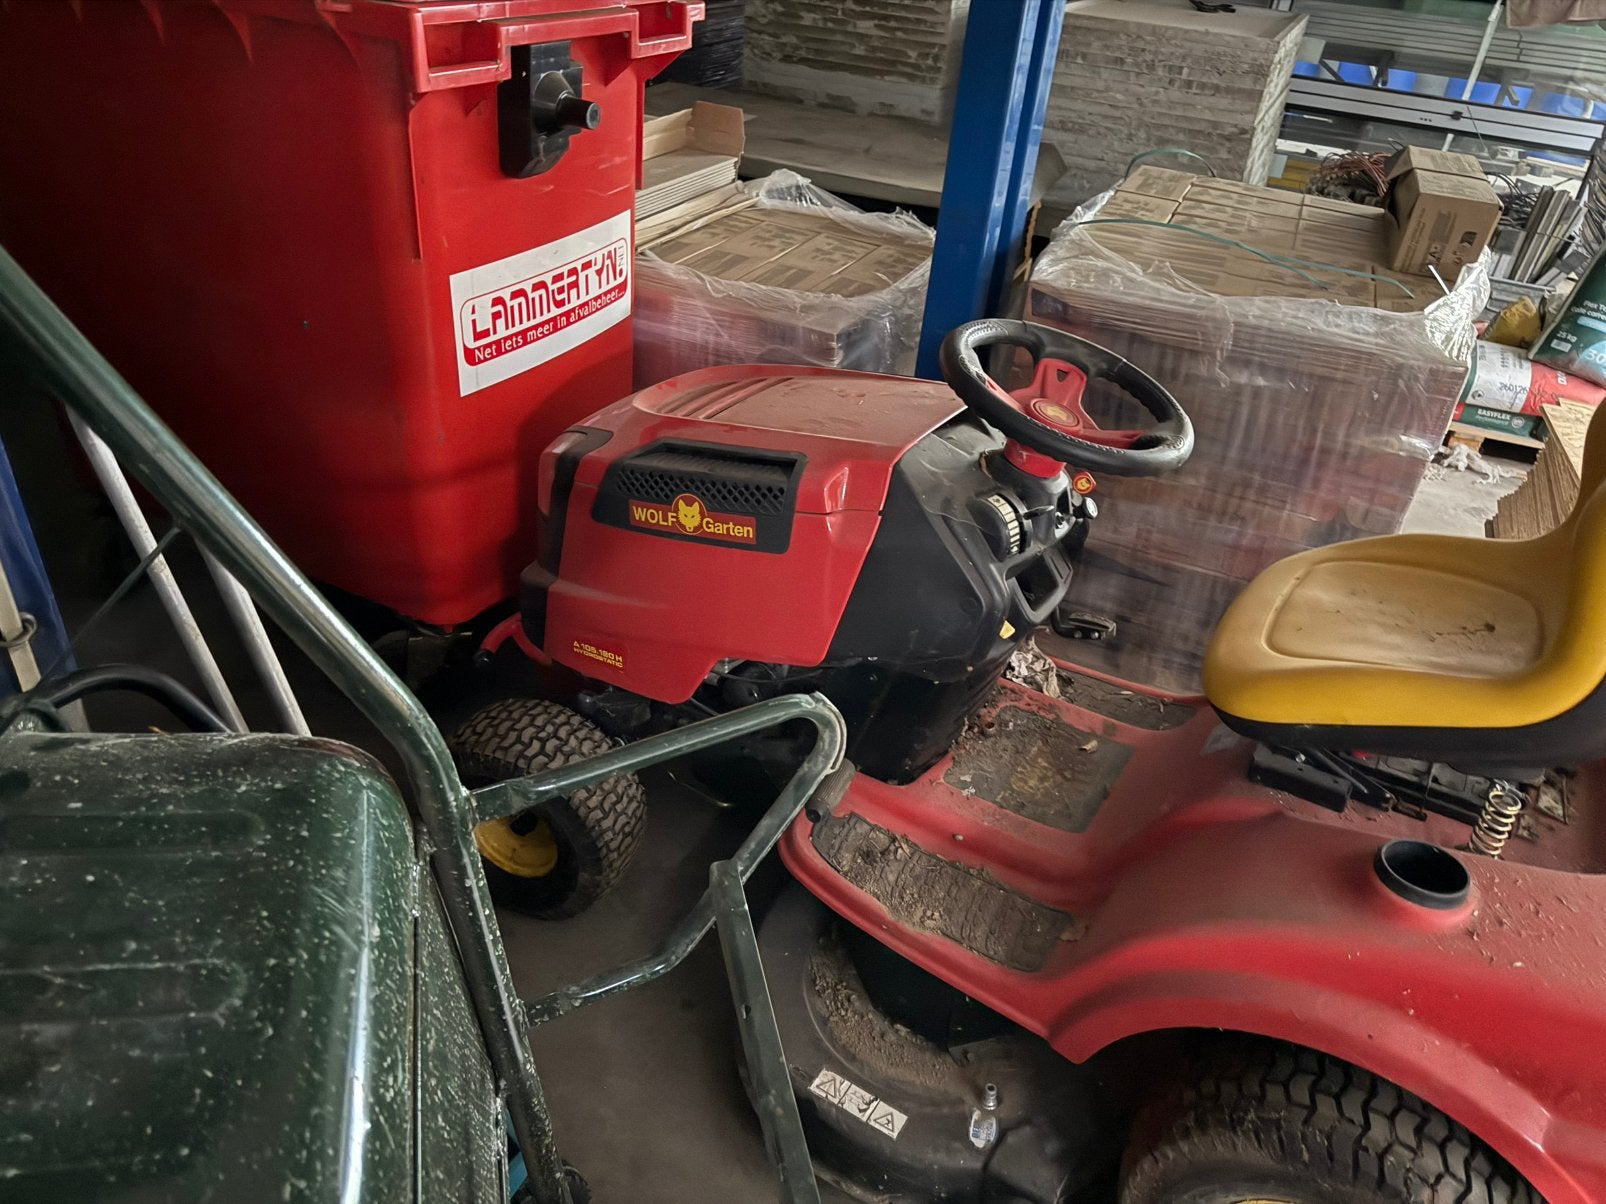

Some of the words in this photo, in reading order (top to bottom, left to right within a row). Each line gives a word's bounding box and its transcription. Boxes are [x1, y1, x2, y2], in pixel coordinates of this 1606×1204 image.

[474, 345, 497, 362] Net
[501, 335, 523, 353] iets
[527, 321, 554, 342] meer
[557, 316, 567, 329] in
[569, 289, 626, 323] afvalbeheer...
[1477, 408, 1511, 420] EASYFLEX
[632, 505, 677, 527] WOLF
[702, 517, 753, 539] Garten
[573, 640, 580, 648] A
[615, 654, 623, 662] H
[573, 646, 623, 668] HYDROSTATIC
